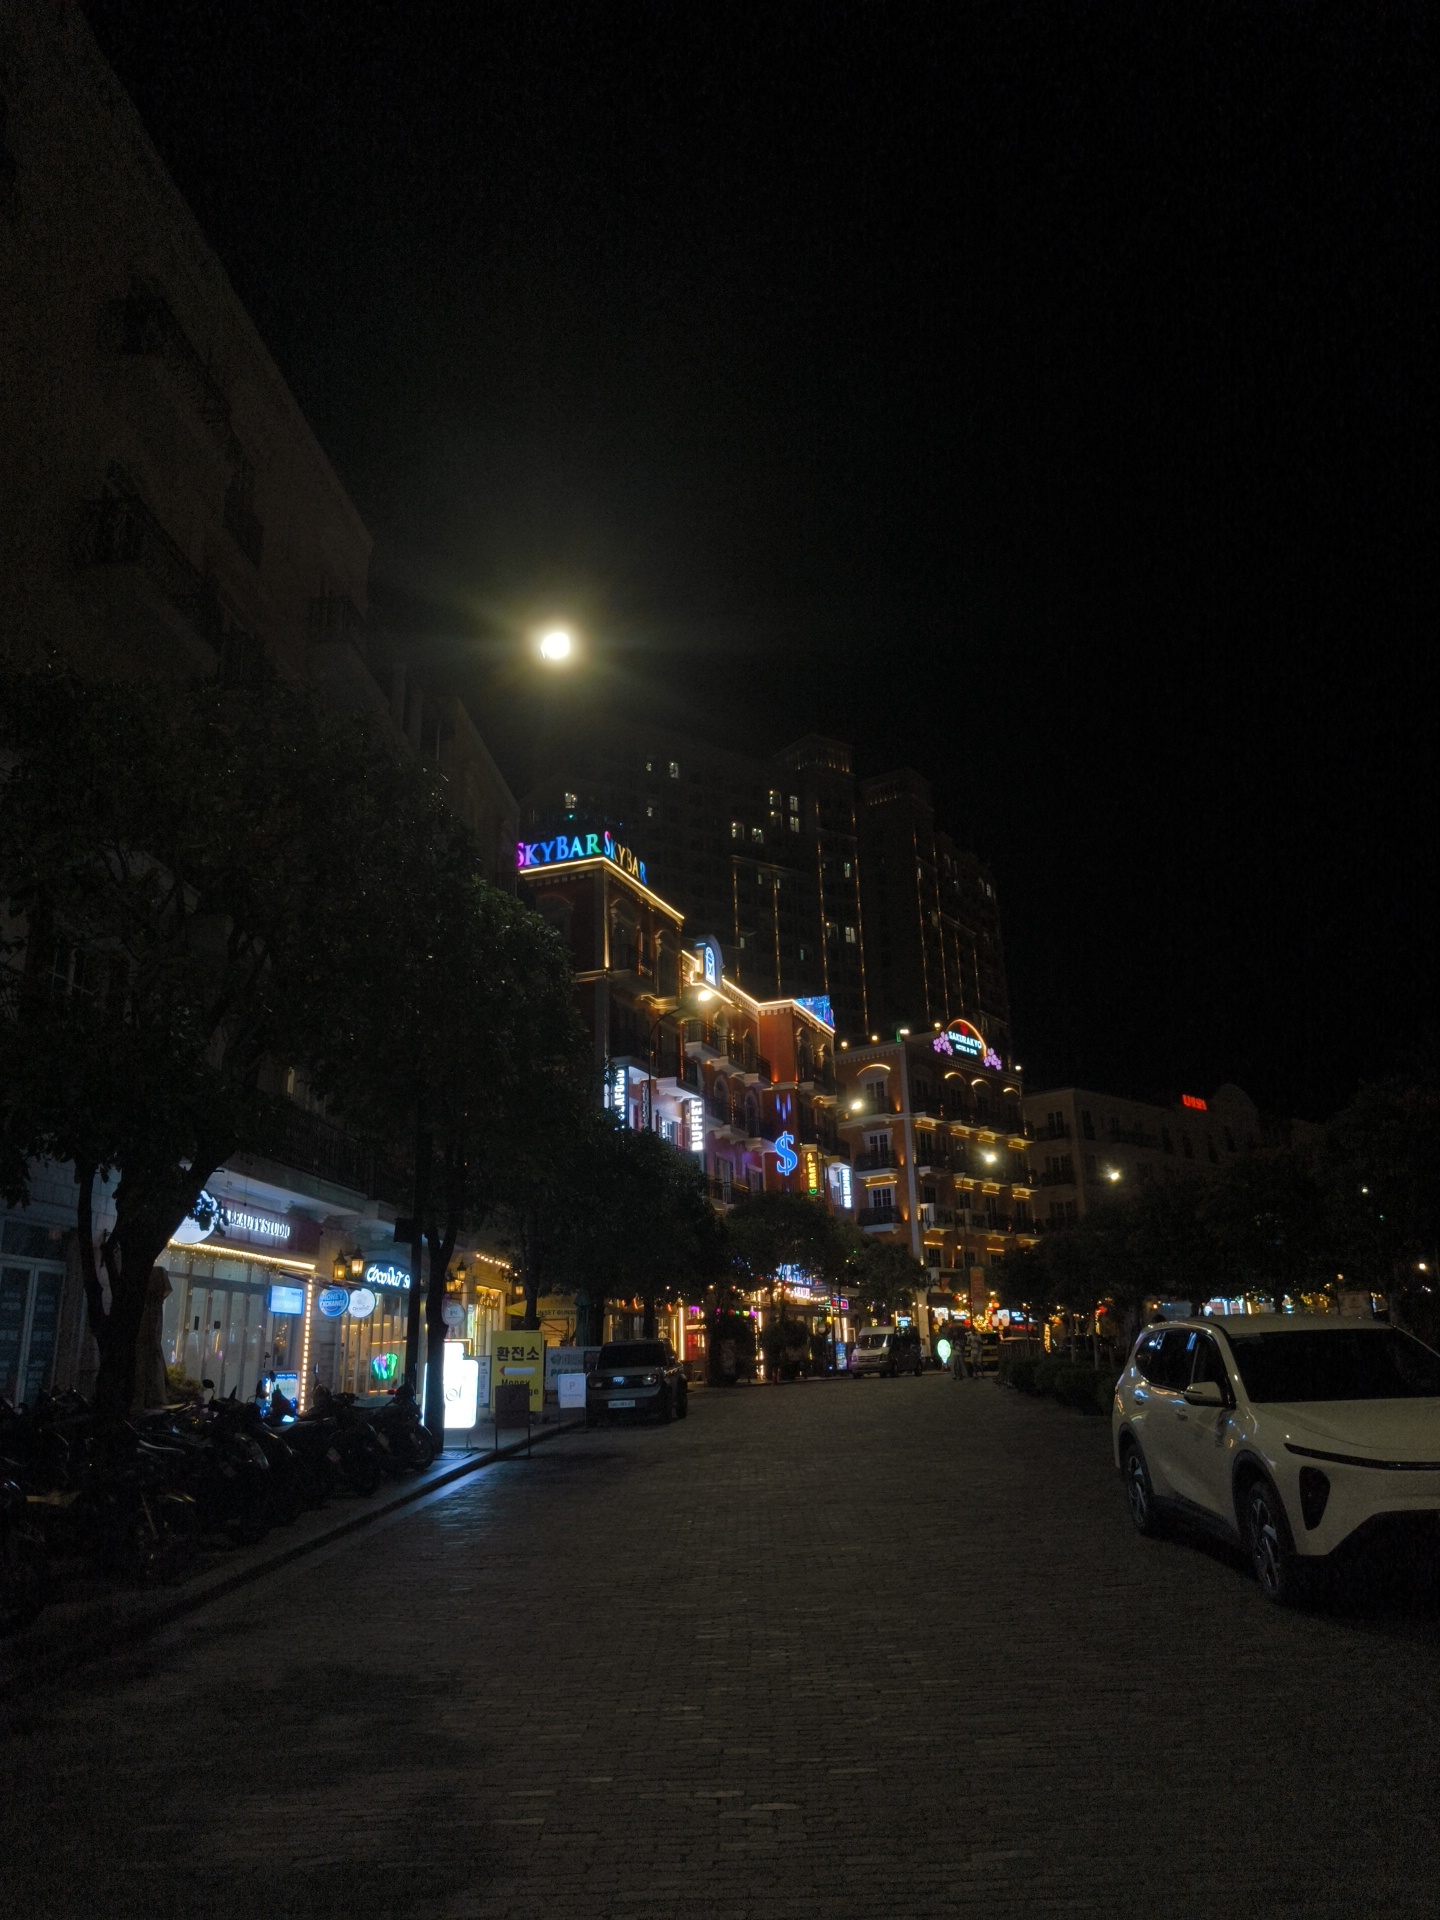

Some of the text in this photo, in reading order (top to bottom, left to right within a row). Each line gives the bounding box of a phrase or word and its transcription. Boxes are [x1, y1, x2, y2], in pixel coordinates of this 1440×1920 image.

[517, 834, 602, 867] SKYBAR
[604, 831, 647, 885] SKYBAR
[691, 1100, 704, 1151] BUFFET
[808, 1162, 817, 1188] MART
[229, 1210, 291, 1238] BEAUTY STUDIO
[322, 1292, 344, 1300] MONEY
[497, 1346, 539, 1361] 환전소
